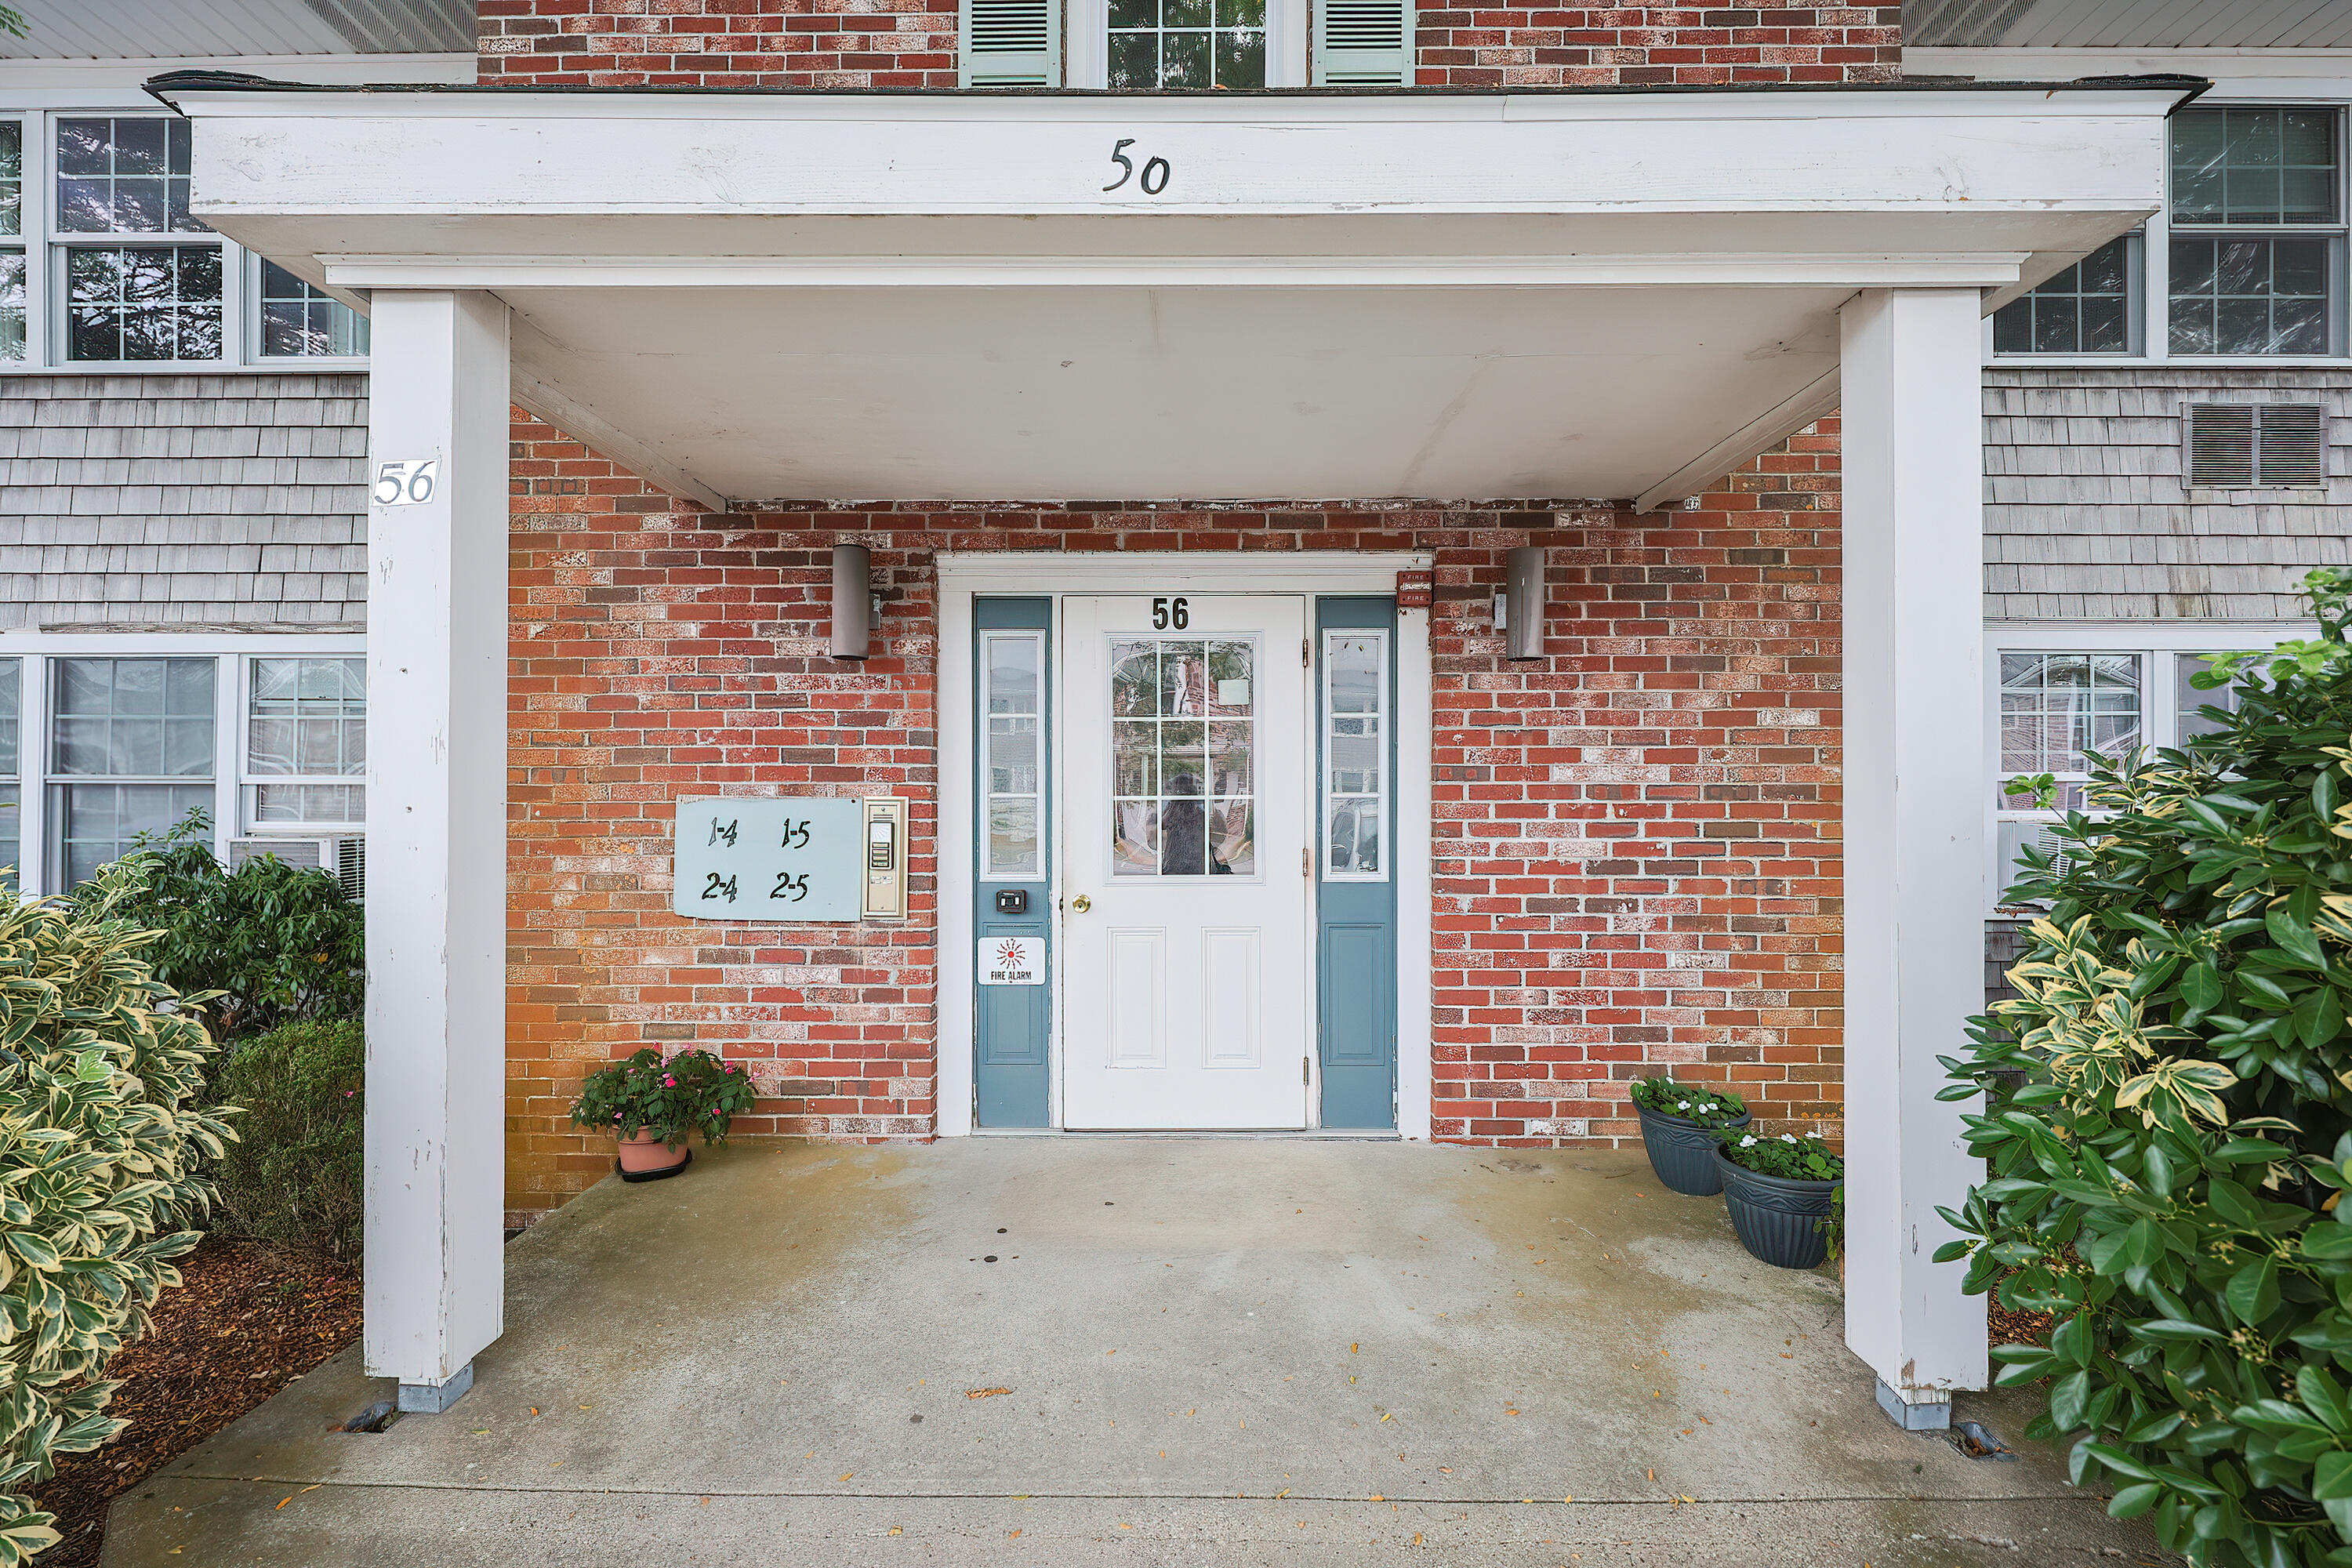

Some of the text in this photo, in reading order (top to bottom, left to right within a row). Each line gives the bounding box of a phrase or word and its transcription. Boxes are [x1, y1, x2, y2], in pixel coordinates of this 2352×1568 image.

[1102, 139, 1171, 194] 50
[374, 460, 436, 504] 56
[1152, 597, 1189, 630] 56
[708, 817, 811, 849] 1-4 1-5
[702, 872, 810, 903] 2-4 2-5
[991, 971, 1032, 980] FIRE ALARM
